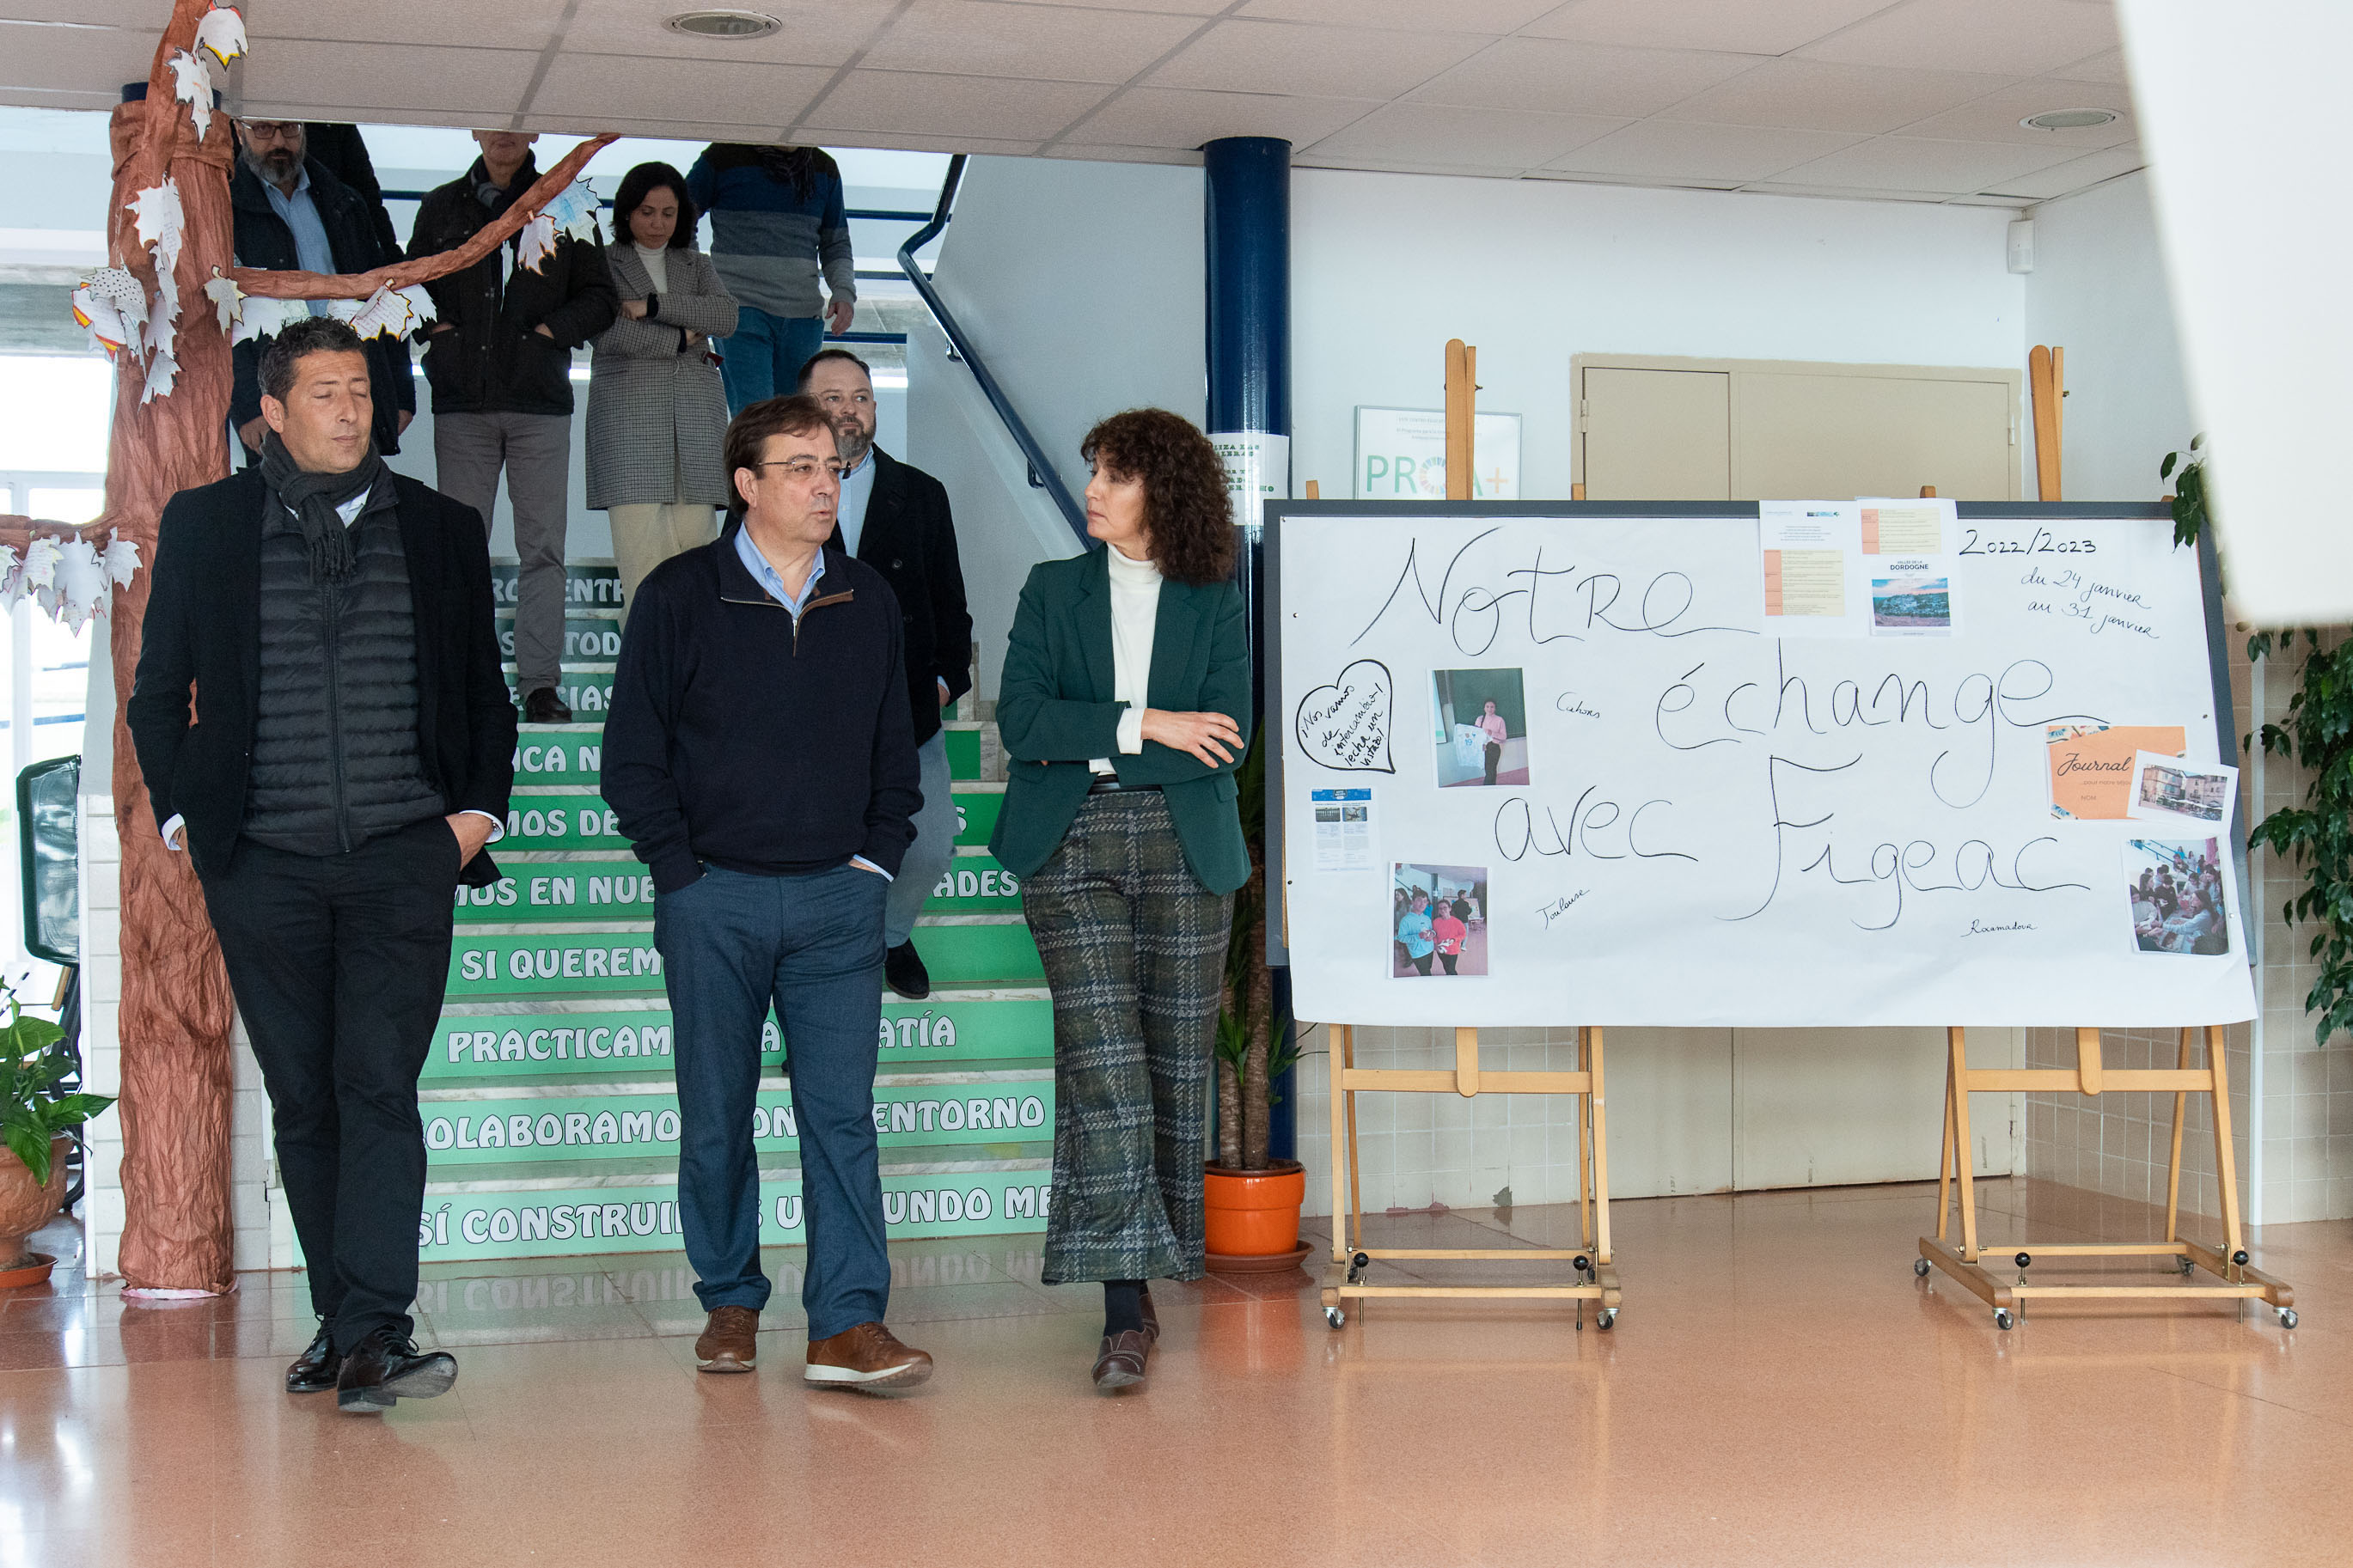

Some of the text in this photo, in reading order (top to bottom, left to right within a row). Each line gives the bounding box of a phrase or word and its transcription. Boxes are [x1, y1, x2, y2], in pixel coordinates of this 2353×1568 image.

[1959, 527, 2096, 555] 2022/2023
[2020, 567, 2047, 585] du
[2052, 570, 2081, 589] 24
[2027, 601, 2051, 613] au
[2062, 602, 2093, 619] 31
[1325, 685, 1354, 719] vamos
[1368, 711, 1384, 731] un
[1656, 637, 2111, 808] échange
[2057, 753, 2131, 776] Journal
[1494, 784, 1699, 862] avec
[1714, 753, 2090, 930] Figeac
[529, 876, 576, 906] EN
[589, 876, 655, 905] NUE
[461, 949, 498, 980] SI
[447, 1025, 672, 1063] PRACTICAM
[874, 1095, 1046, 1133] ENTORNO
